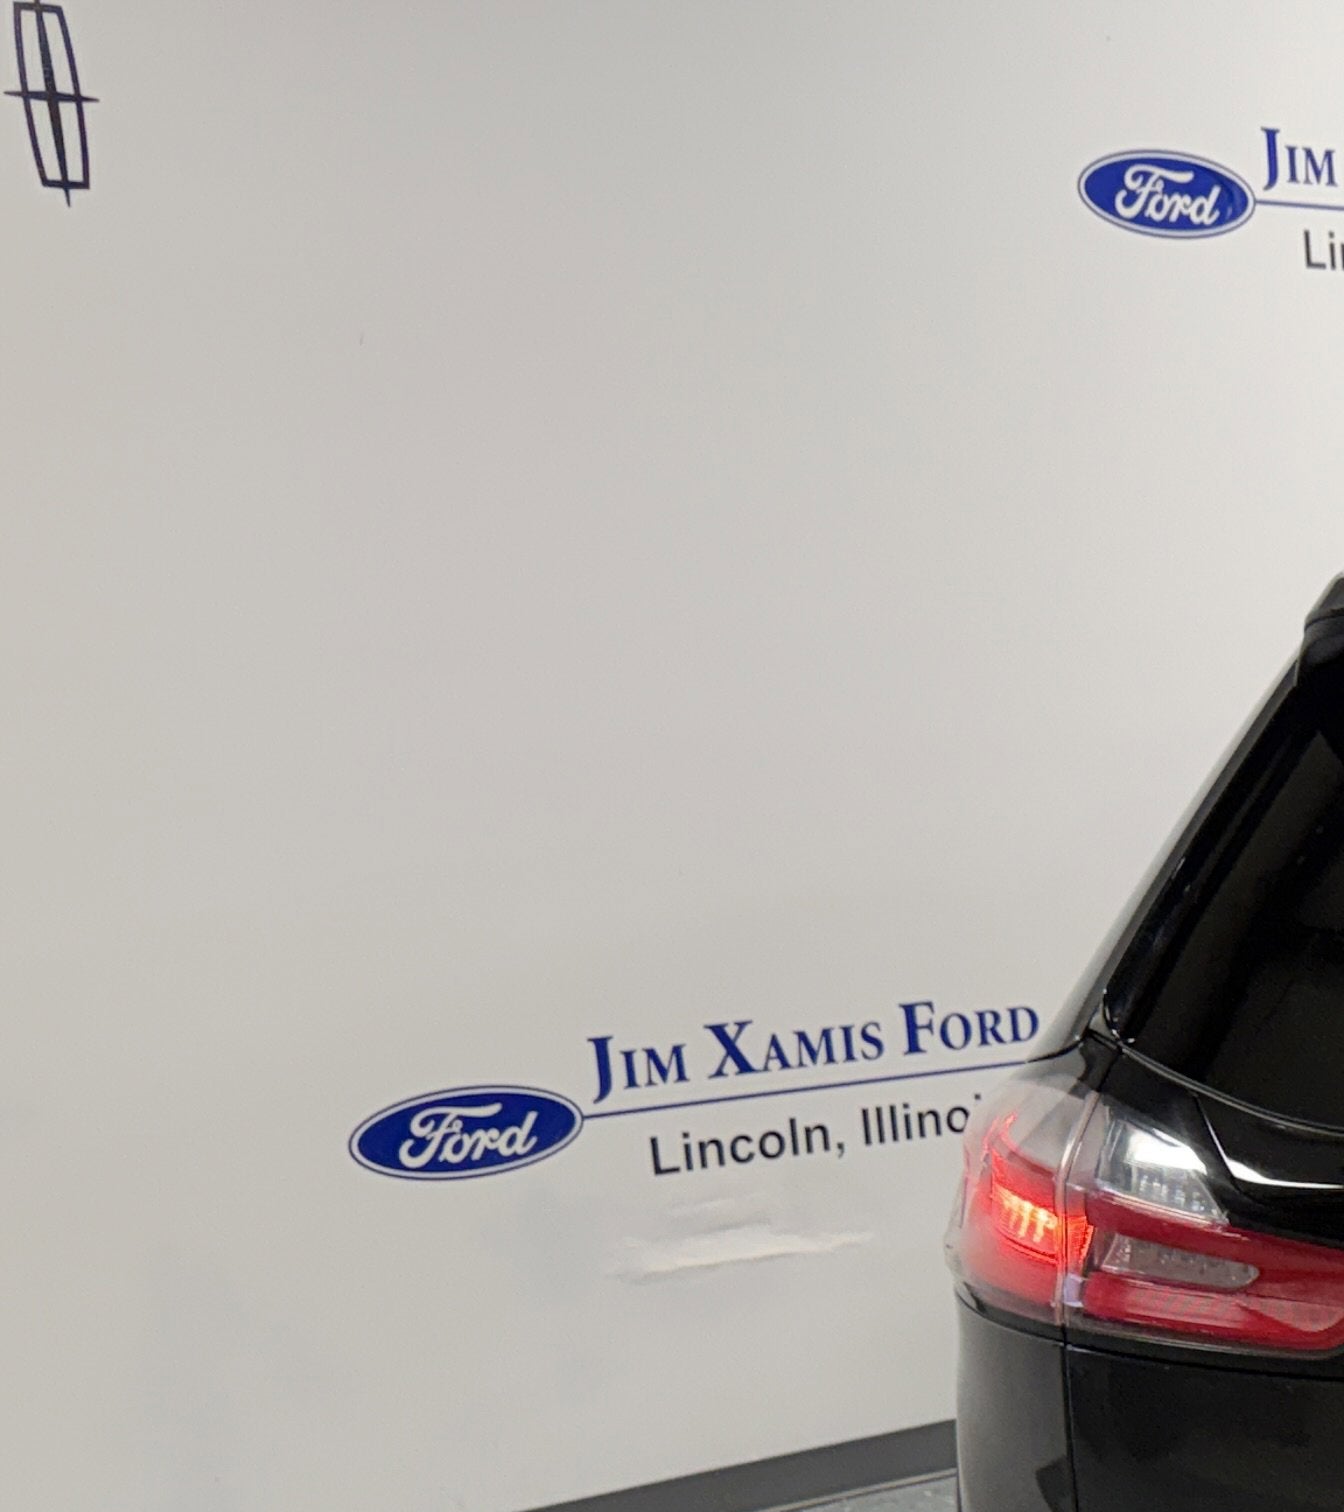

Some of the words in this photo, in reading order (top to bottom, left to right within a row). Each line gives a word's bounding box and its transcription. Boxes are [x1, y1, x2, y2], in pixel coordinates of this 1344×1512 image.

[1261, 126, 1338, 190] JIM
[1115, 164, 1220, 226] Ford
[586, 1035, 690, 1103] JIM
[703, 1020, 884, 1079] XAMIS
[899, 1001, 1039, 1055] FORD
[399, 1103, 537, 1168] Ford
[650, 1117, 845, 1176] Lincoln,
[860, 1093, 981, 1147] Illino
